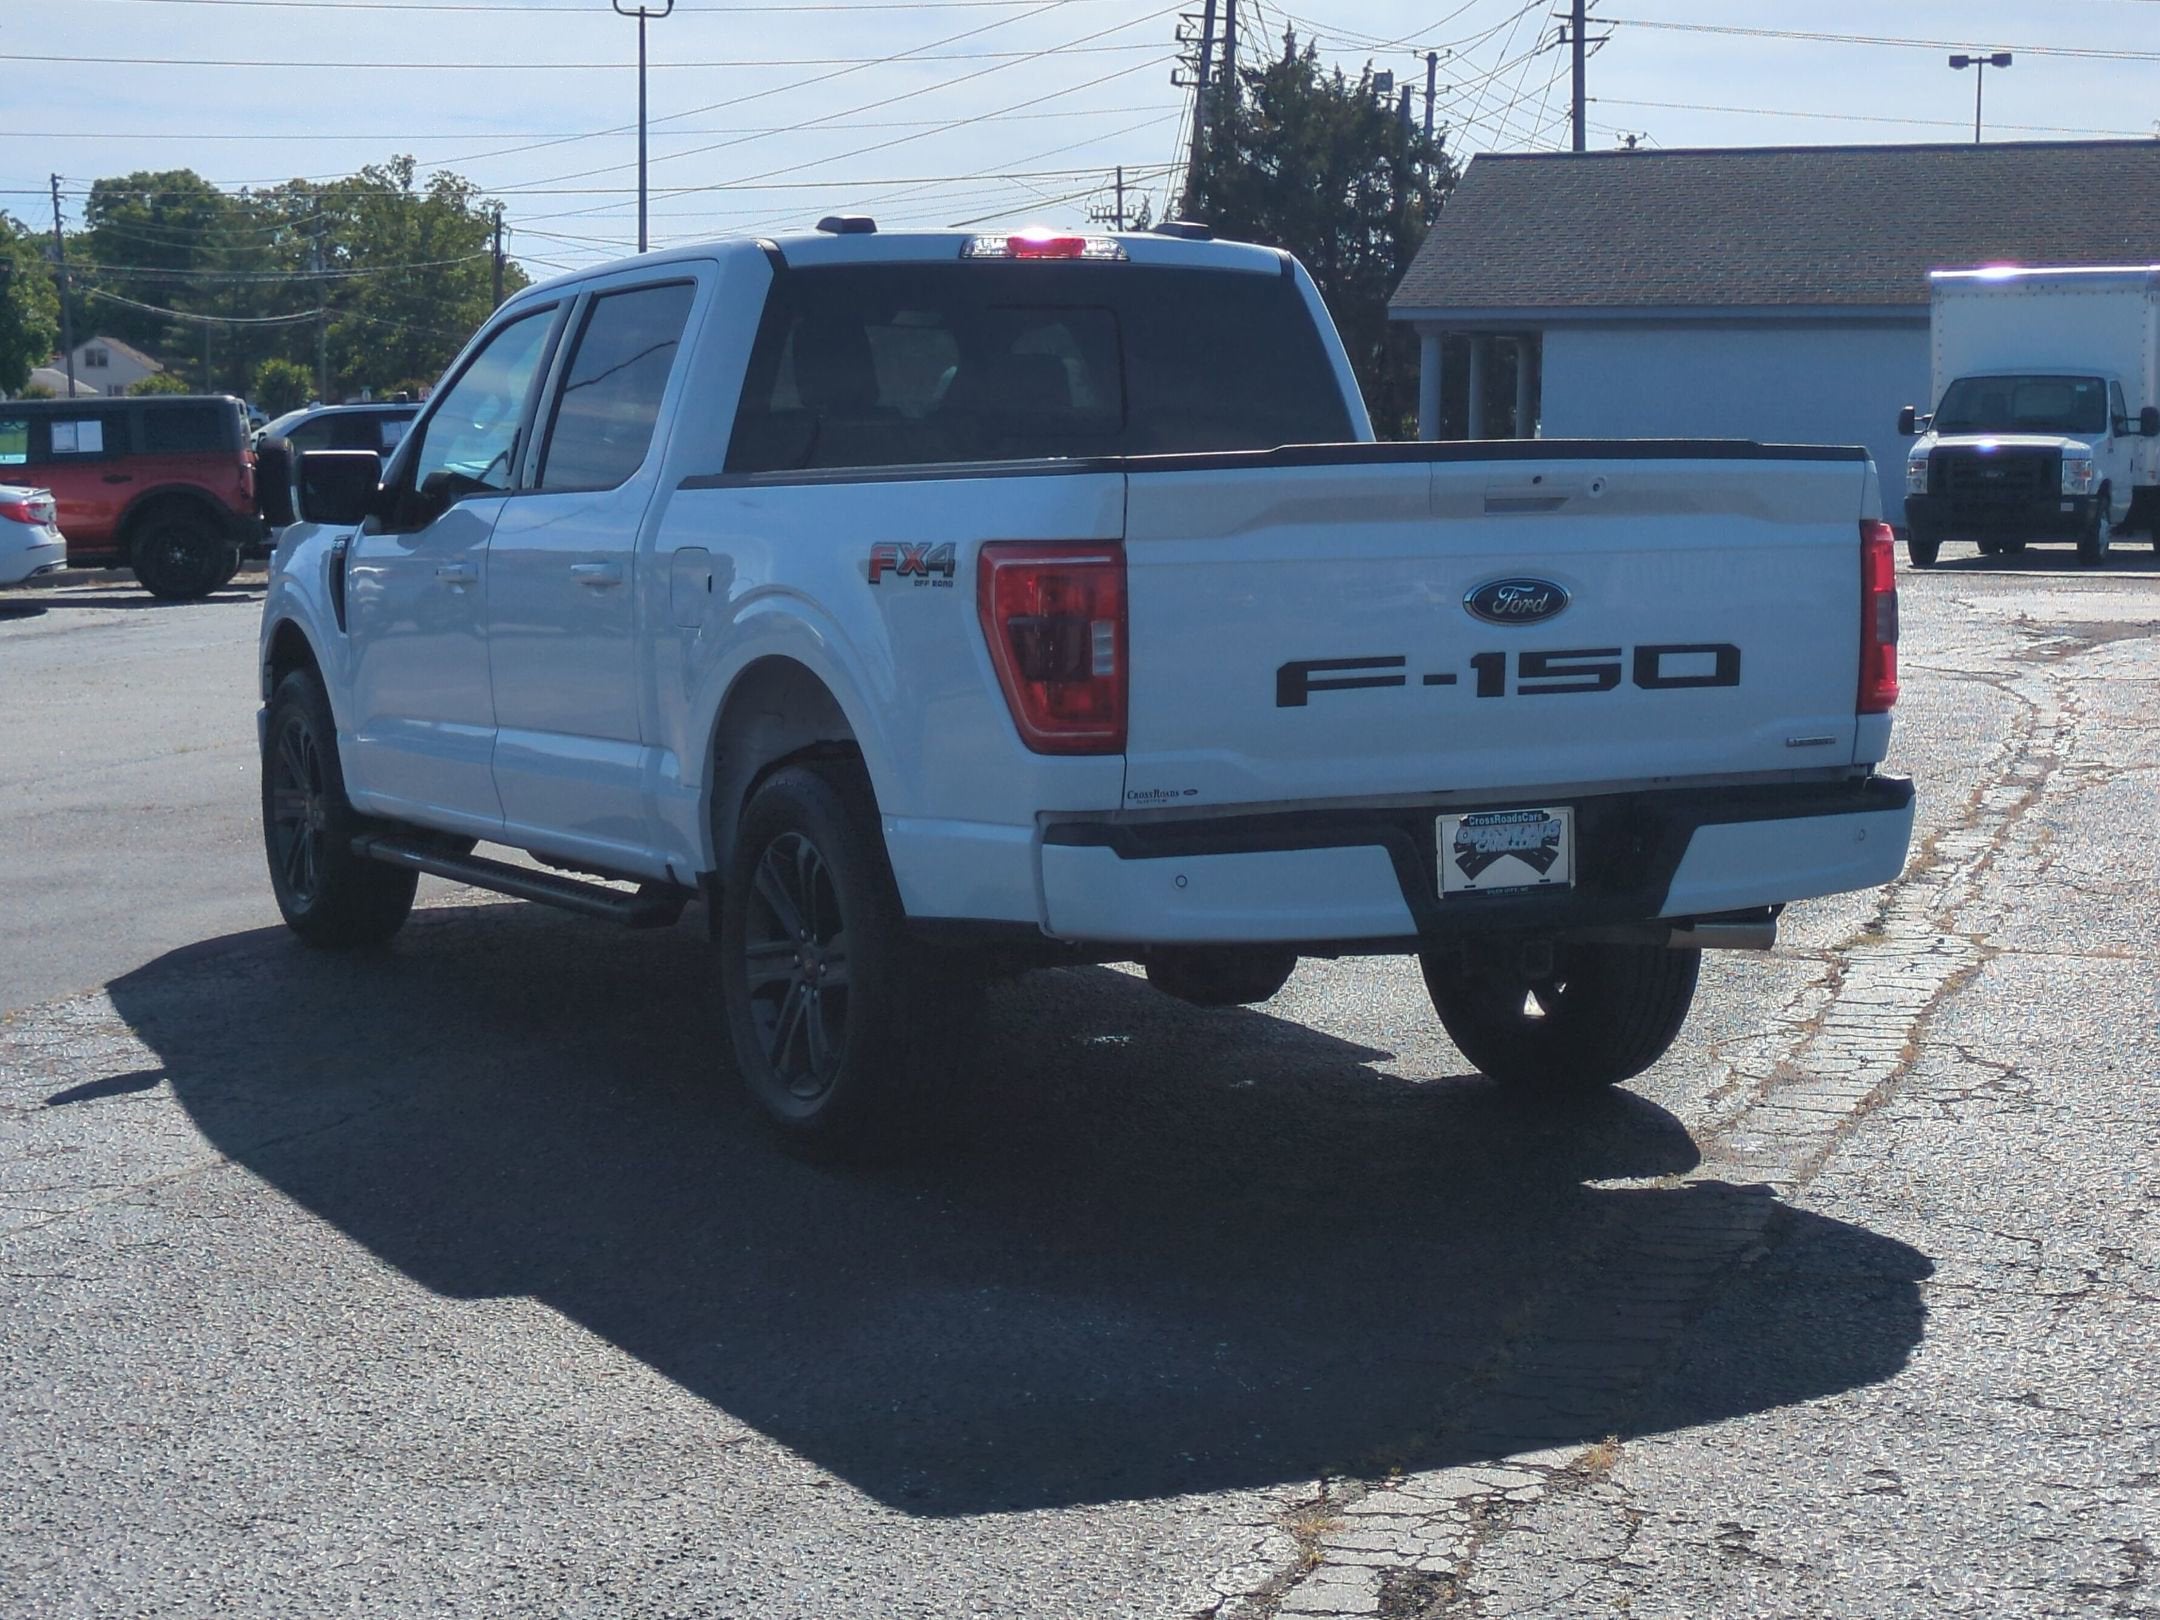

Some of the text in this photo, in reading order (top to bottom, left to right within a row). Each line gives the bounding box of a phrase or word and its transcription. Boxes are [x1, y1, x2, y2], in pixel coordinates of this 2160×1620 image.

[868, 542, 956, 585] FX4
[1492, 585, 1549, 614] Ford
[1276, 643, 1741, 708] F-150
[1468, 812, 1543, 826] CrossRoadsCars
